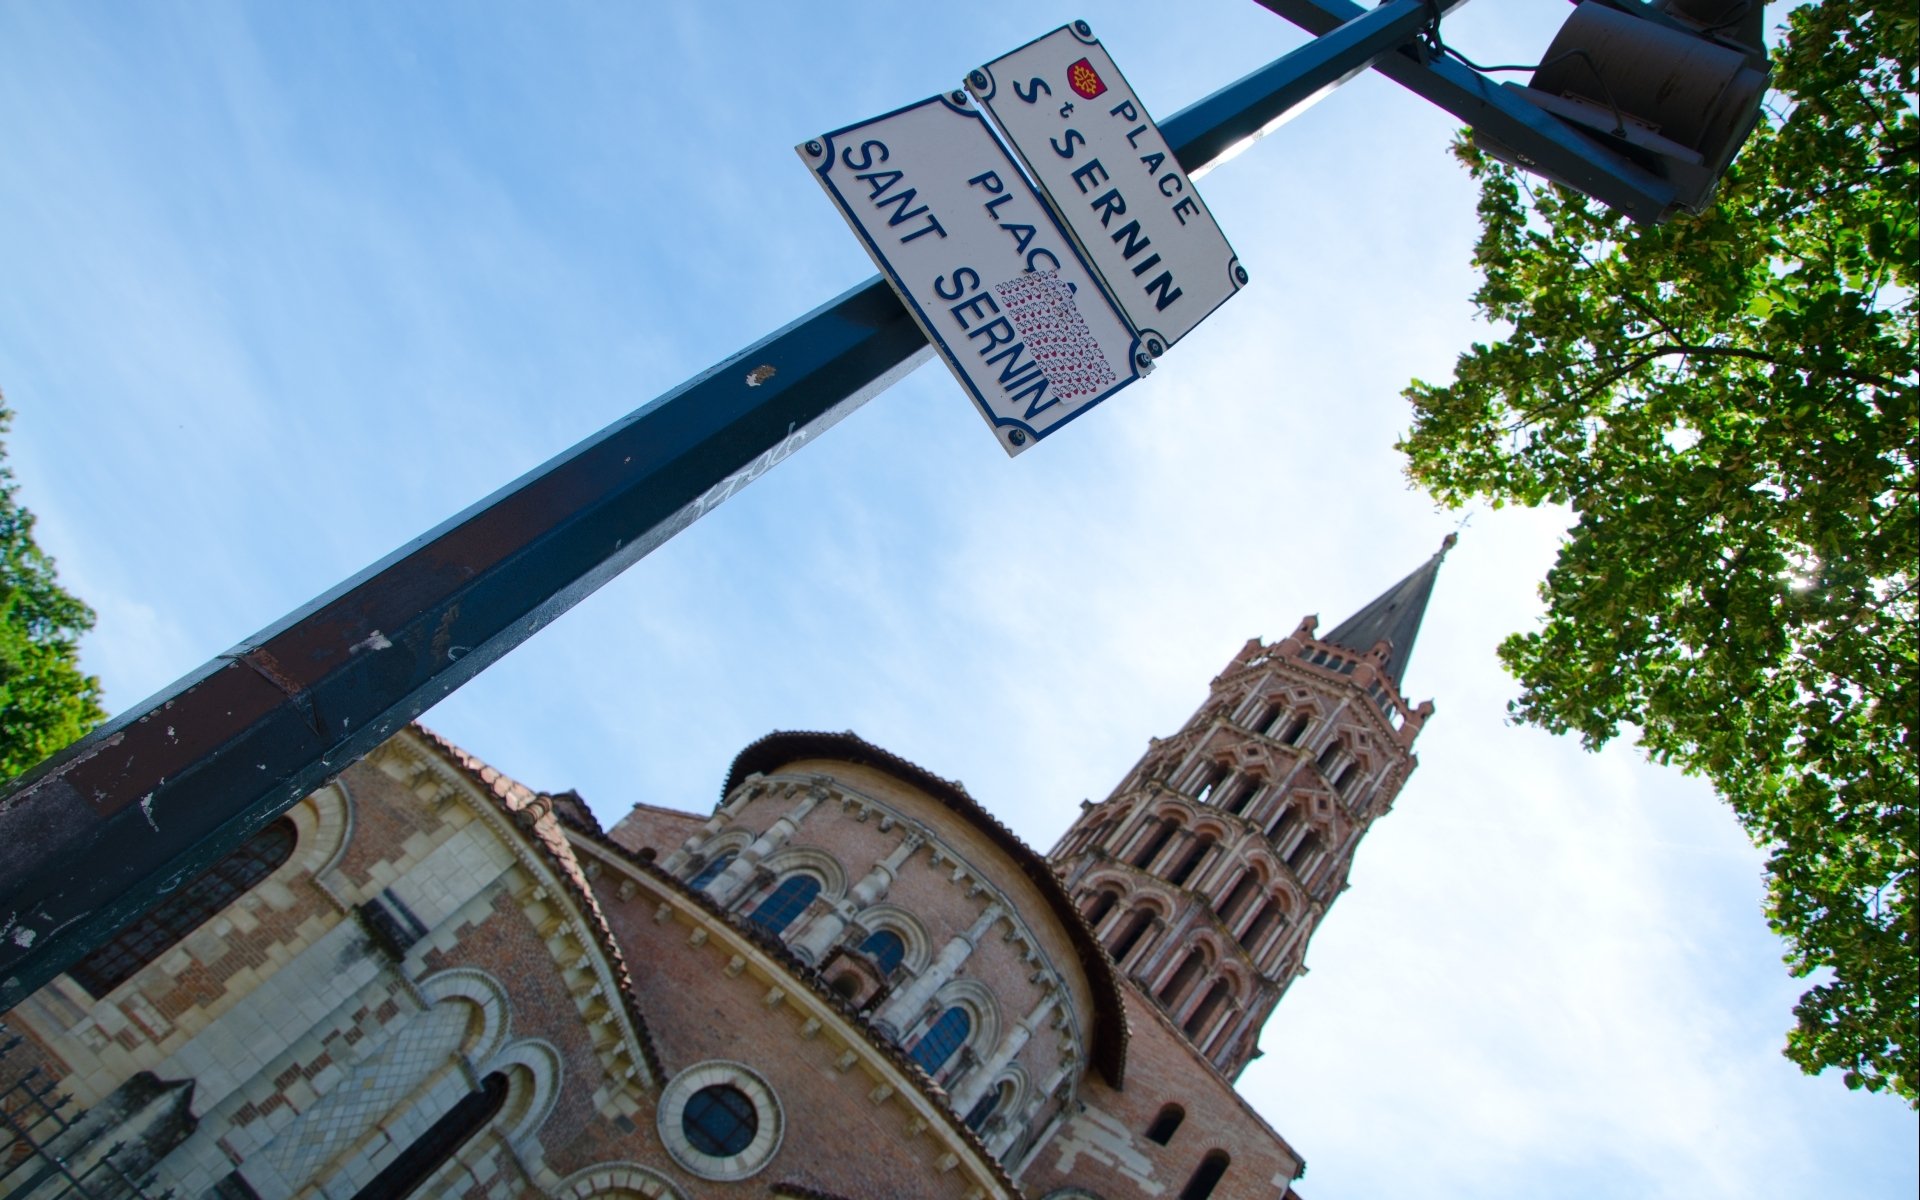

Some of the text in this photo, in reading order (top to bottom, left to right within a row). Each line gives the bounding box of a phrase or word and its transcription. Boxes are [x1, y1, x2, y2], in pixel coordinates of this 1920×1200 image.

[968, 169, 1077, 295] PLAÇ
[1050, 128, 1183, 313] SERNIN
[1110, 99, 1200, 228] PLACE
[842, 139, 1062, 421] SANT SERNIN
